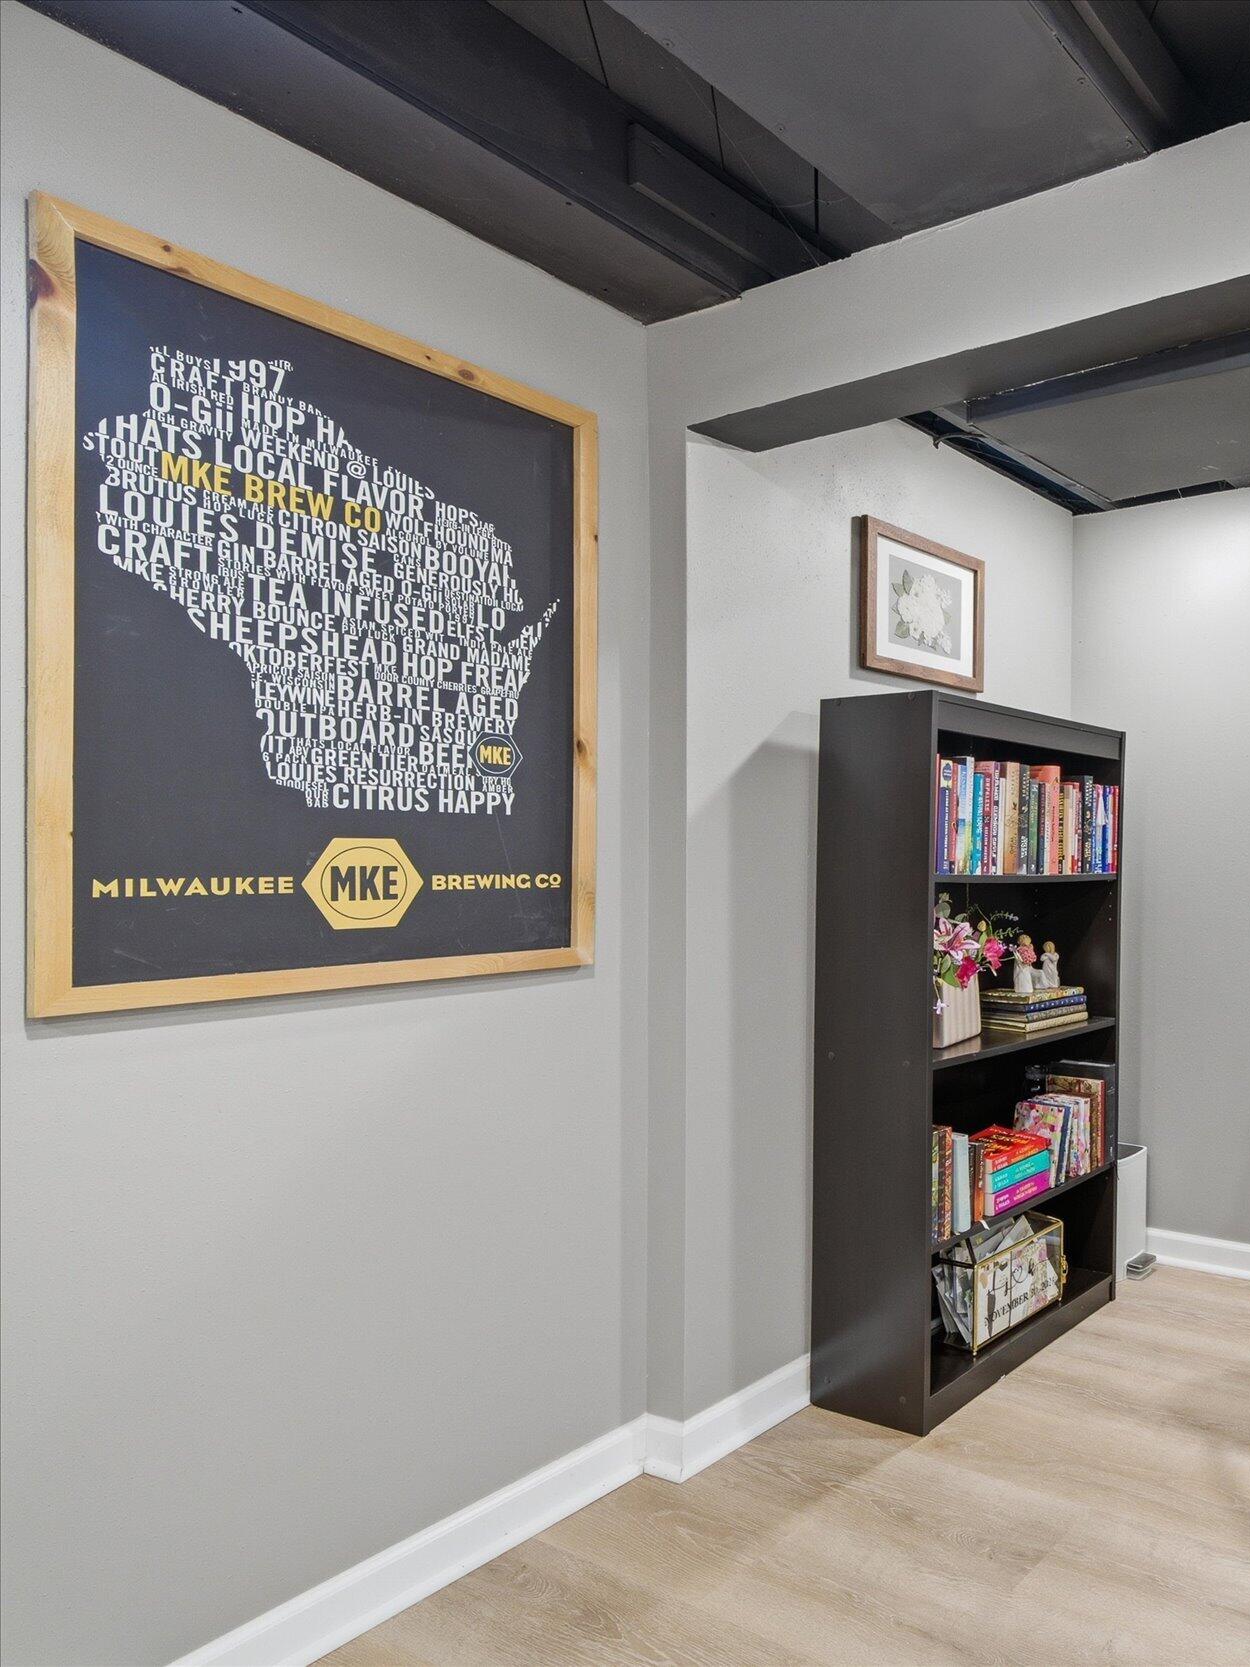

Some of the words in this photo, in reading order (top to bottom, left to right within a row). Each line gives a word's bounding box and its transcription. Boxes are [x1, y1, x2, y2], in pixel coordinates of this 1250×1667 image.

[150, 353, 235, 396] CRAFT
[176, 350, 211, 370] BUYS
[172, 377, 206, 397] IRISH
[211, 390, 233, 405] RED
[242, 391, 305, 432] HOP
[181, 418, 232, 441] GRAVITY
[242, 419, 278, 437] MADE
[306, 438, 378, 466] MILWAUKEE
[241, 427, 339, 471] WEEKEND
[118, 459, 158, 477] OUNCE
[216, 438, 313, 491] LOCAL
[324, 470, 423, 521] FLAVOR
[162, 450, 232, 496] MKE
[245, 474, 334, 520] BREW
[345, 501, 381, 533] CO
[203, 490, 246, 509] CREAM
[100, 484, 238, 542] LOUIES
[256, 522, 376, 574] DEMISE
[105, 513, 138, 530] WITH
[143, 522, 213, 546] CHARACTER
[385, 511, 488, 553] WOLFHOUND
[435, 501, 479, 528] HOPS
[98, 524, 213, 573] CRAFT
[279, 510, 350, 542] CITRON
[358, 529, 421, 559] SAISON
[386, 528, 431, 547] ALCOHOL
[217, 540, 255, 565] GIN
[264, 550, 341, 582] BARREL
[346, 568, 394, 592] AGED
[218, 558, 271, 577] STORIES
[276, 569, 305, 584] WITH
[394, 562, 498, 600] GENEROUSLY
[248, 574, 307, 610] TEA
[322, 588, 444, 634] INFUSED
[253, 601, 336, 632] BOUNCE
[398, 595, 434, 609] POTATO
[187, 608, 397, 666] SHEEPSHEAD
[447, 620, 485, 642] ELFS
[402, 636, 460, 660] GRAND
[467, 646, 531, 672] MADAME
[402, 652, 453, 681] HOP
[461, 661, 530, 692] FREAK
[338, 675, 445, 712] BARREL
[455, 692, 518, 720] AGED
[256, 708, 414, 748] OUTBOARD
[338, 700, 422, 725] HERB-IN
[432, 711, 516, 735] BREWERY
[276, 753, 307, 764] PACK
[311, 748, 373, 769] GREEN
[379, 753, 418, 772] TIER
[480, 744, 511, 765] MKE
[266, 761, 337, 783] LOUIES
[344, 767, 475, 791] RESURRECTION
[333, 783, 429, 812] CITRUS
[438, 789, 515, 815] HAPPY
[92, 876, 294, 898] MILWAUKEE
[330, 866, 398, 900] MKE
[431, 874, 531, 891] BREWING
